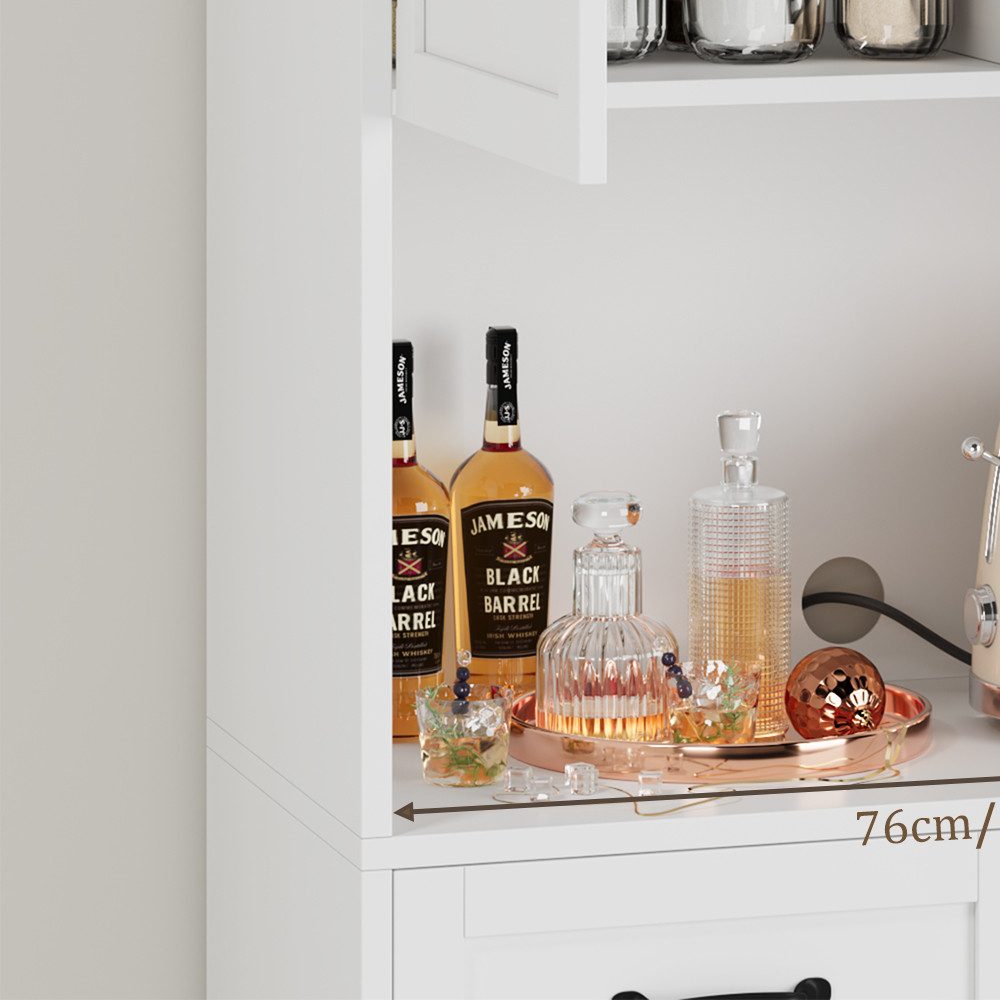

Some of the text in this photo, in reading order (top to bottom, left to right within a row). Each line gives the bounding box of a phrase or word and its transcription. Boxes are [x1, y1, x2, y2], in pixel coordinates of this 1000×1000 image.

[501, 342, 512, 390] JAMESON
[396, 355, 407, 404] JAMESON
[470, 511, 550, 536] JAMESON
[486, 565, 540, 586] BLACK
[484, 593, 541, 614] BARREL
